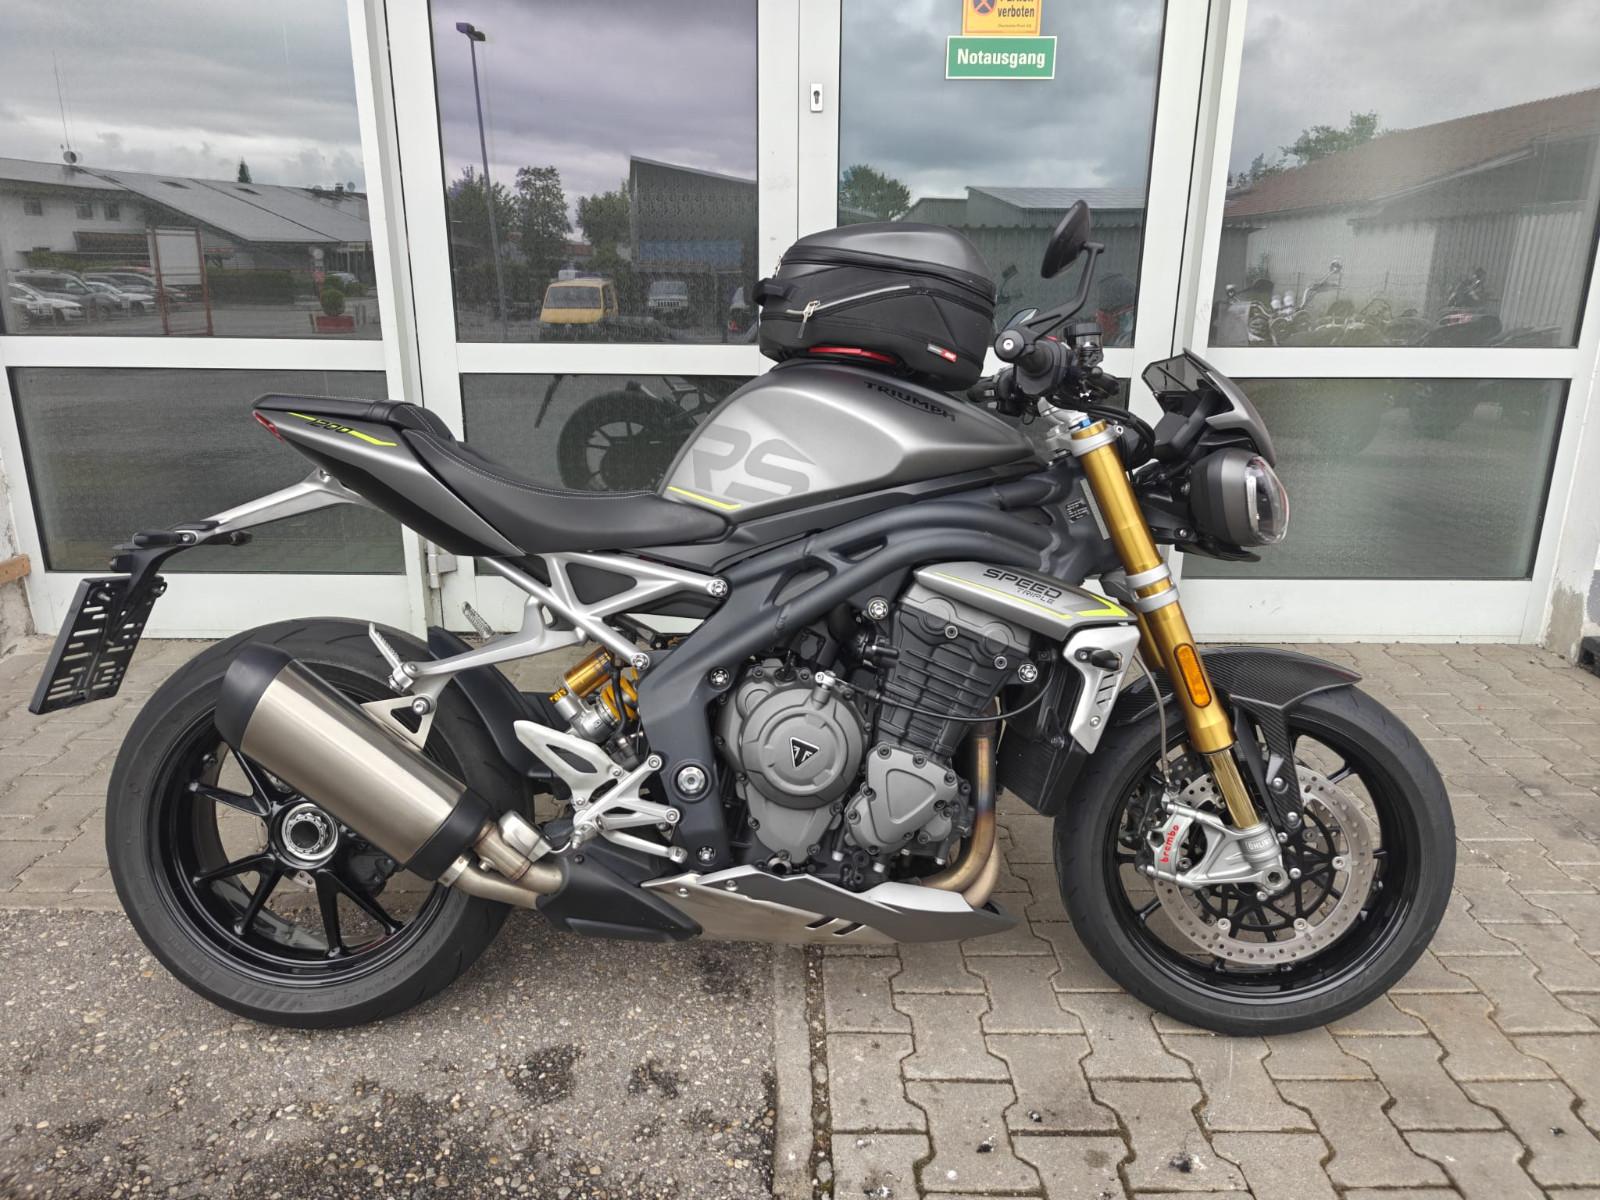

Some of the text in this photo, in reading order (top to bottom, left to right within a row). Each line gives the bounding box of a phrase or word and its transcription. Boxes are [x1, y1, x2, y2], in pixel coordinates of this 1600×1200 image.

[997, 5, 1035, 18] verboten
[957, 48, 1046, 69] Notausgang
[864, 380, 956, 421] TRIUMPH
[692, 423, 817, 503] RS
[983, 568, 1063, 599] SPEED
[1016, 587, 1056, 605] TRIPLE
[1159, 824, 1179, 863] brembo
